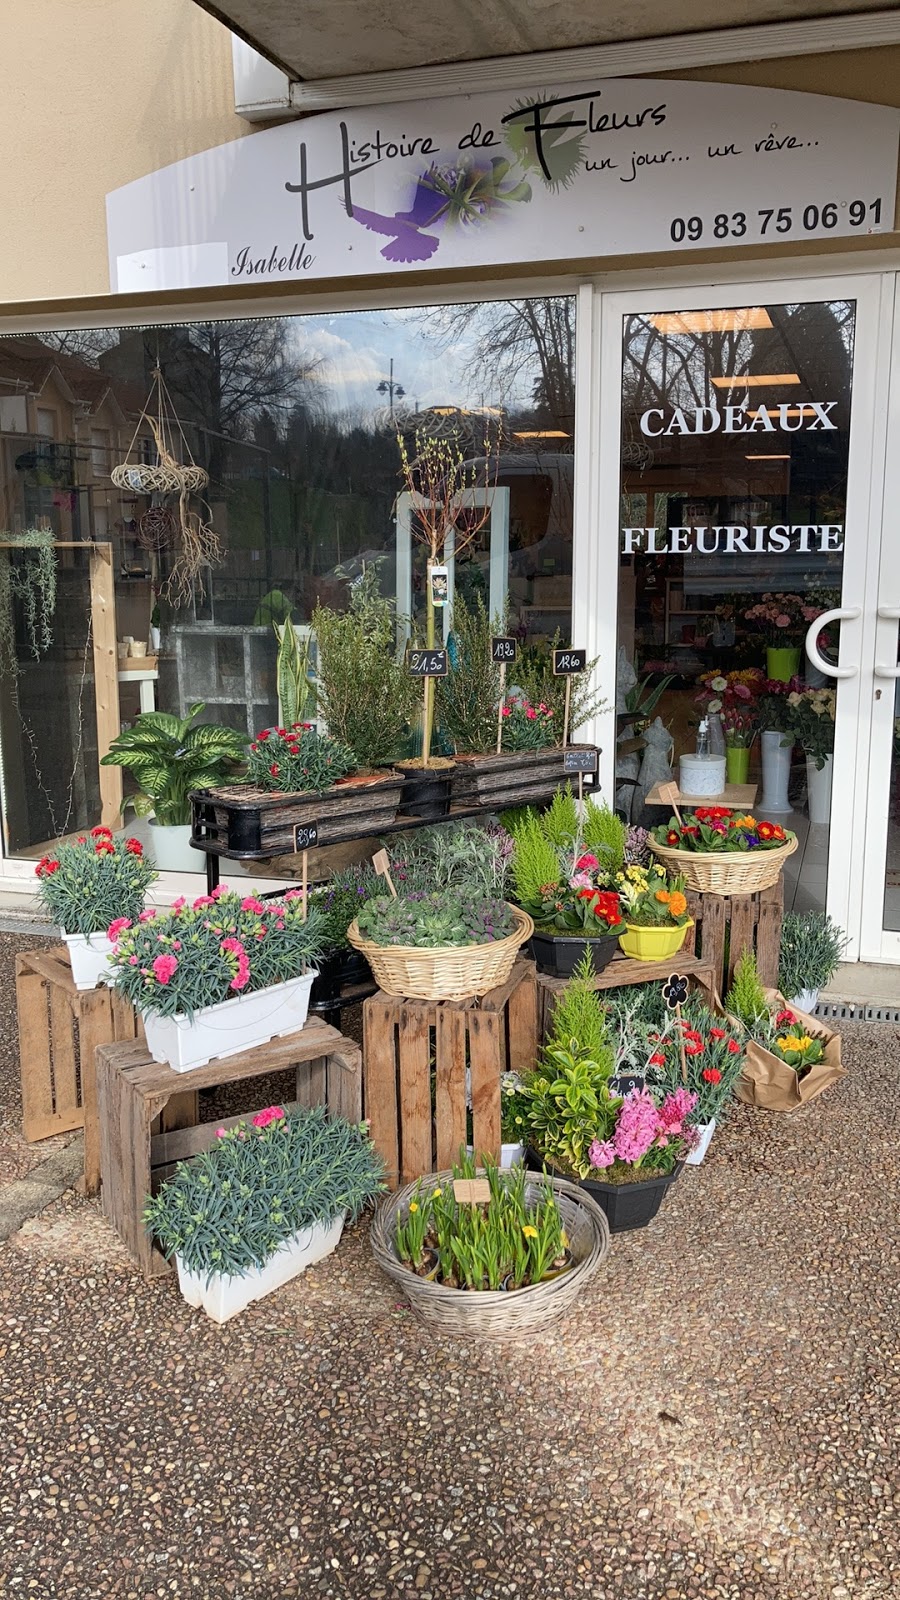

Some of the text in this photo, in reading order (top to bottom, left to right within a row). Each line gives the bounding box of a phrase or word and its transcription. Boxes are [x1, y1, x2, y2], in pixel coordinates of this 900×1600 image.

[285, 90, 667, 240] Histoire de Fleurs
[585, 132, 820, 182] un jour... un rêve...
[670, 198, 882, 242] 09 83 75 06 91
[231, 242, 317, 276] Isabelle
[640, 401, 839, 437] CADEAUX
[621, 524, 844, 554] FLEURISTE
